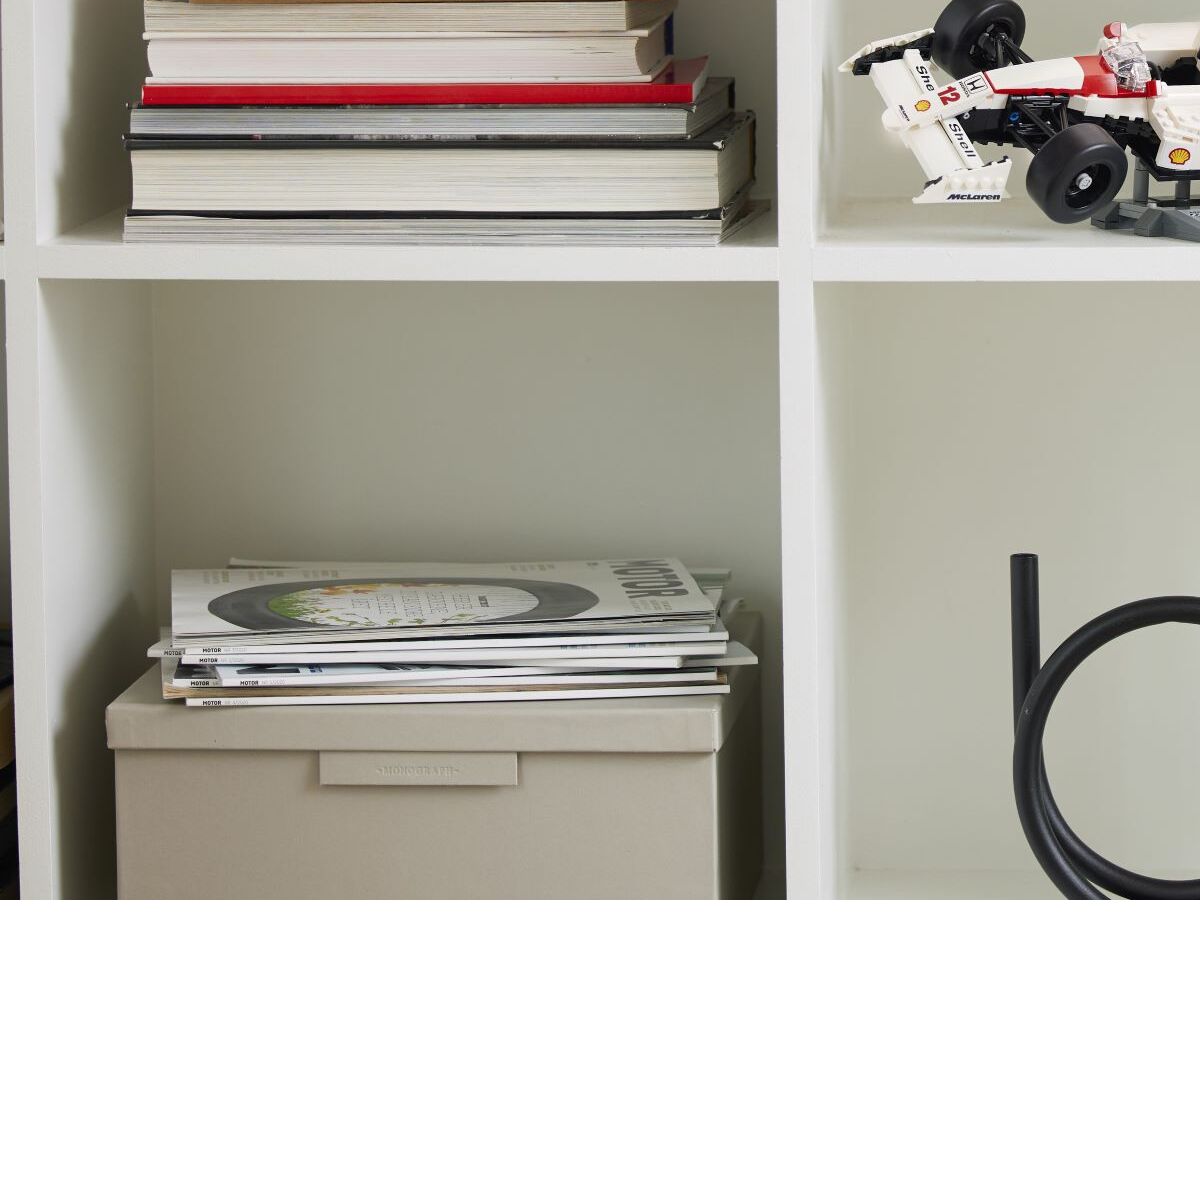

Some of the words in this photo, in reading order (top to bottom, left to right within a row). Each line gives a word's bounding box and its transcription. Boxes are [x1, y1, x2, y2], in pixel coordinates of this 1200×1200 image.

[915, 65, 935, 92] She
[937, 85, 961, 106] 12
[948, 123, 977, 158] Shell
[947, 193, 1001, 201] McLaren
[607, 559, 689, 599] MOTOR
